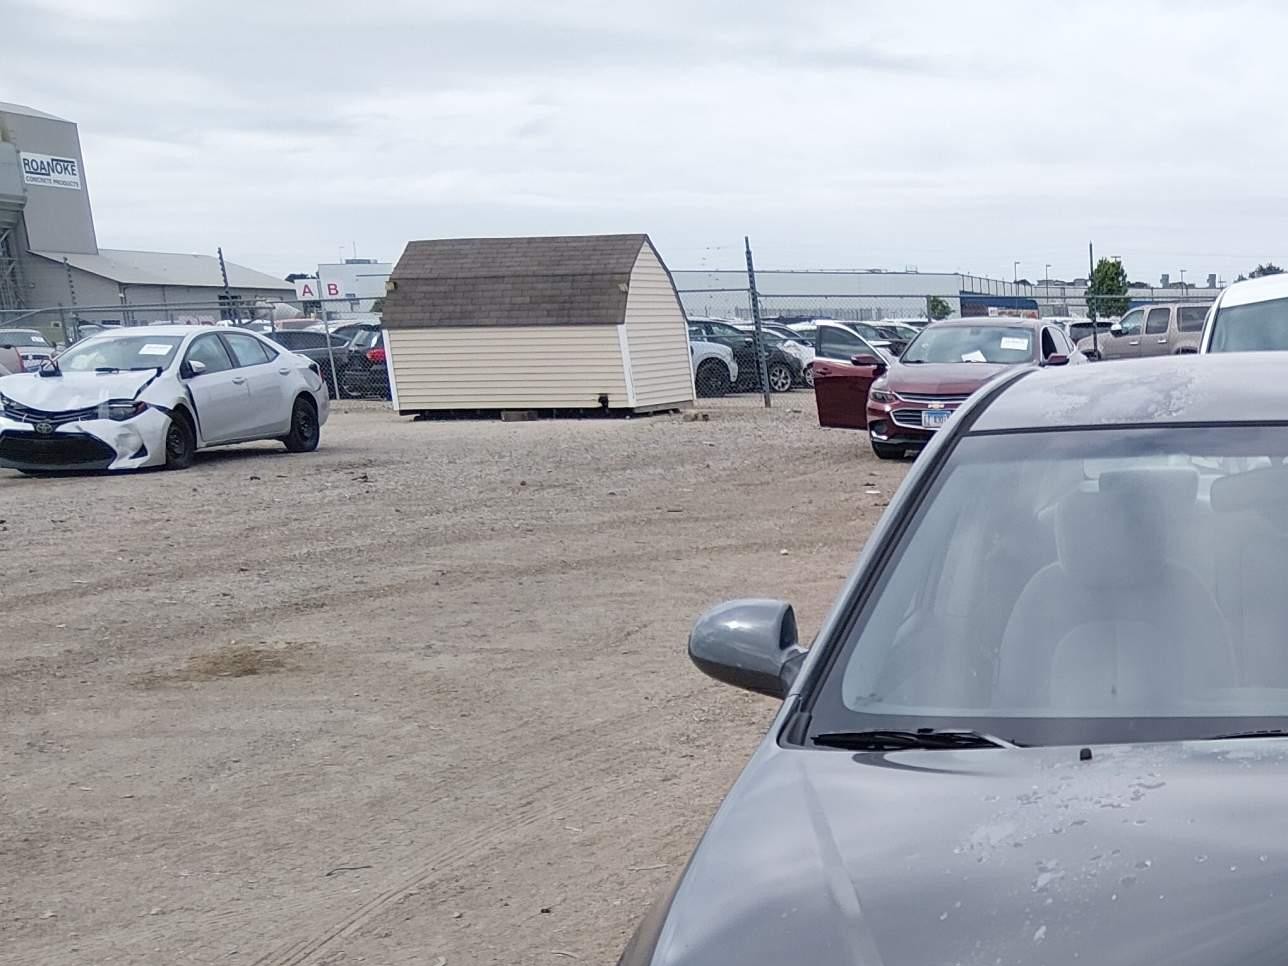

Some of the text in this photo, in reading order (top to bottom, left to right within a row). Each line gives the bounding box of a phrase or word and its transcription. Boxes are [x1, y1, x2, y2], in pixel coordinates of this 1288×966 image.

[23, 158, 77, 176] ROANOKE
[302, 284, 314, 296] A
[327, 283, 339, 296] B
